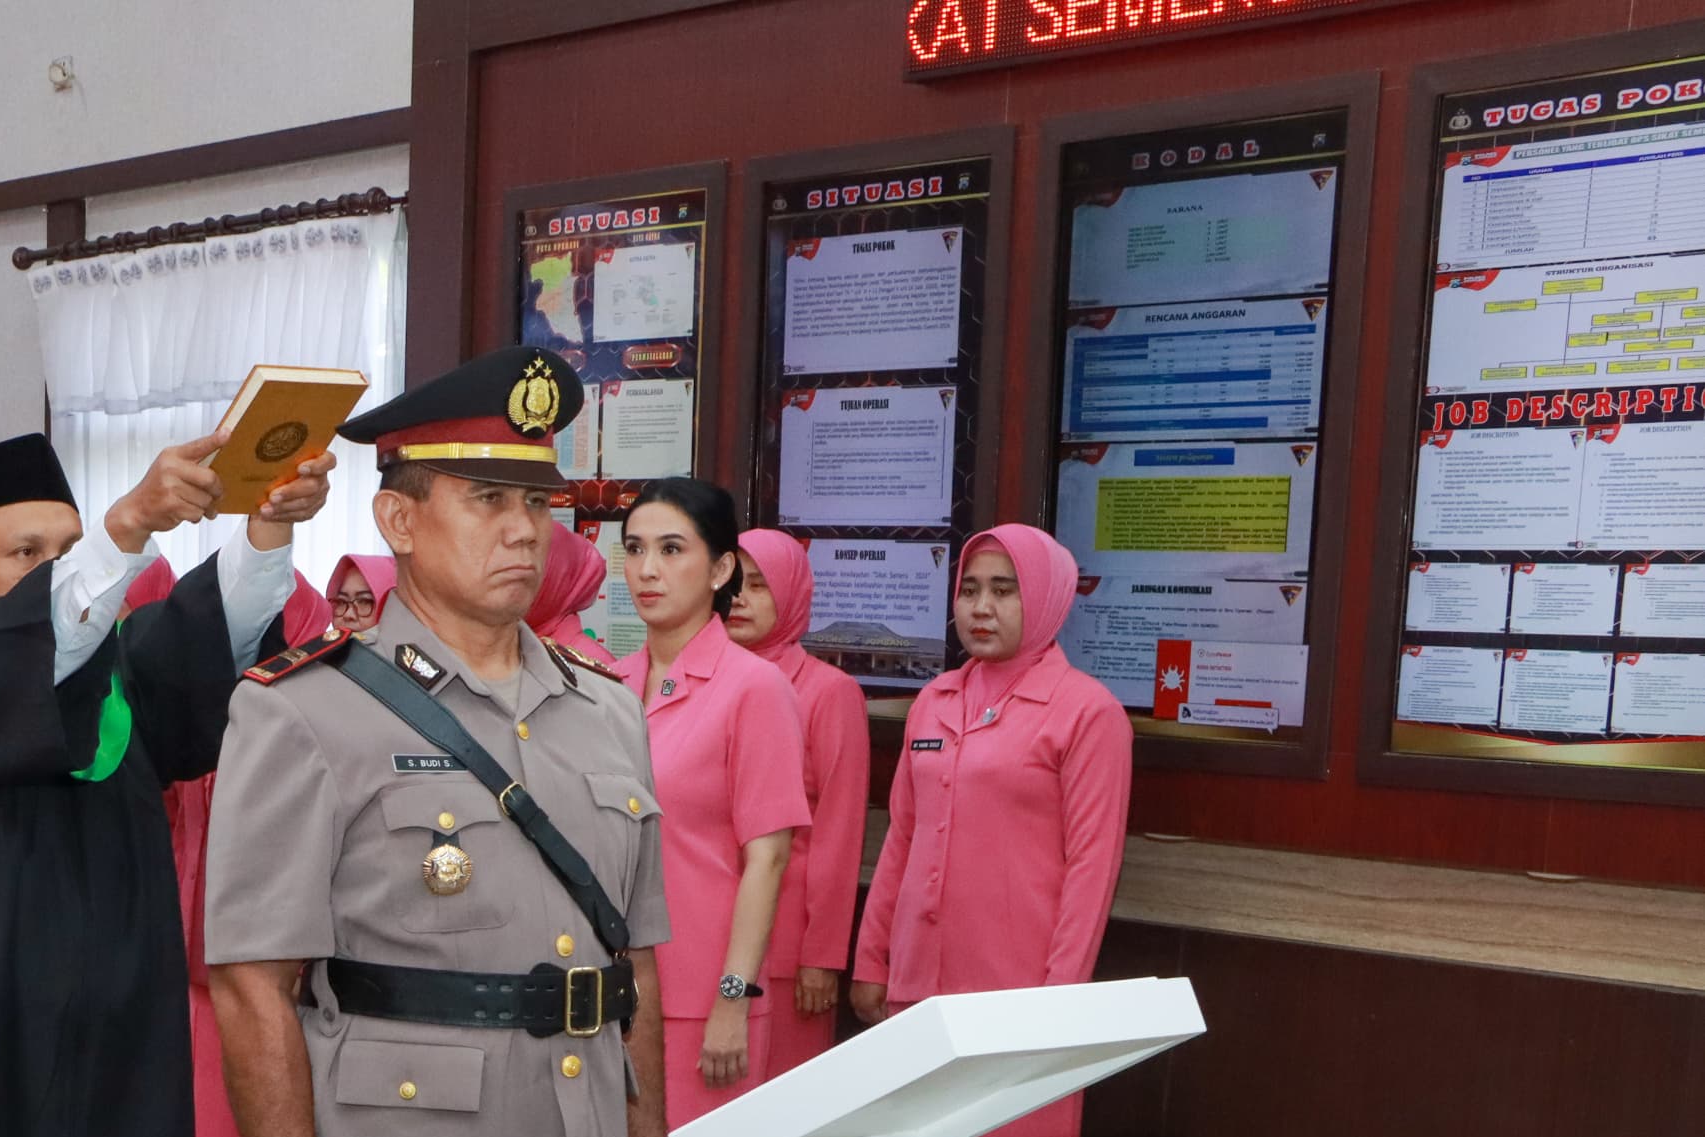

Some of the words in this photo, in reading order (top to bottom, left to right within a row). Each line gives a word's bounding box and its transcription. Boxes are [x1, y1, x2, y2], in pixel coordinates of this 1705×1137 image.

[1484, 93, 1601, 127] TUGAS
[1617, 78, 1705, 110] POK
[1132, 140, 1259, 170] KODAL
[807, 177, 943, 209] SITUASI
[549, 206, 660, 236] SITUASI
[872, 239, 895, 252] POKOK
[1545, 266, 1594, 276] STRUKTUR
[1595, 261, 1654, 273] ORGANISASI
[1145, 311, 1189, 323] RENCANA
[1191, 308, 1246, 320] ANGGARAN
[1433, 400, 1489, 432] JOB
[1506, 384, 1705, 423] DESCRIPTI
[834, 549, 858, 561] KONSEP
[859, 550, 886, 561] OPERASI
[1131, 583, 1166, 595] JARINGAN
[1167, 584, 1213, 596] KOMUNIKASI
[407, 759, 417, 767] S.
[420, 759, 441, 767] BUDI
